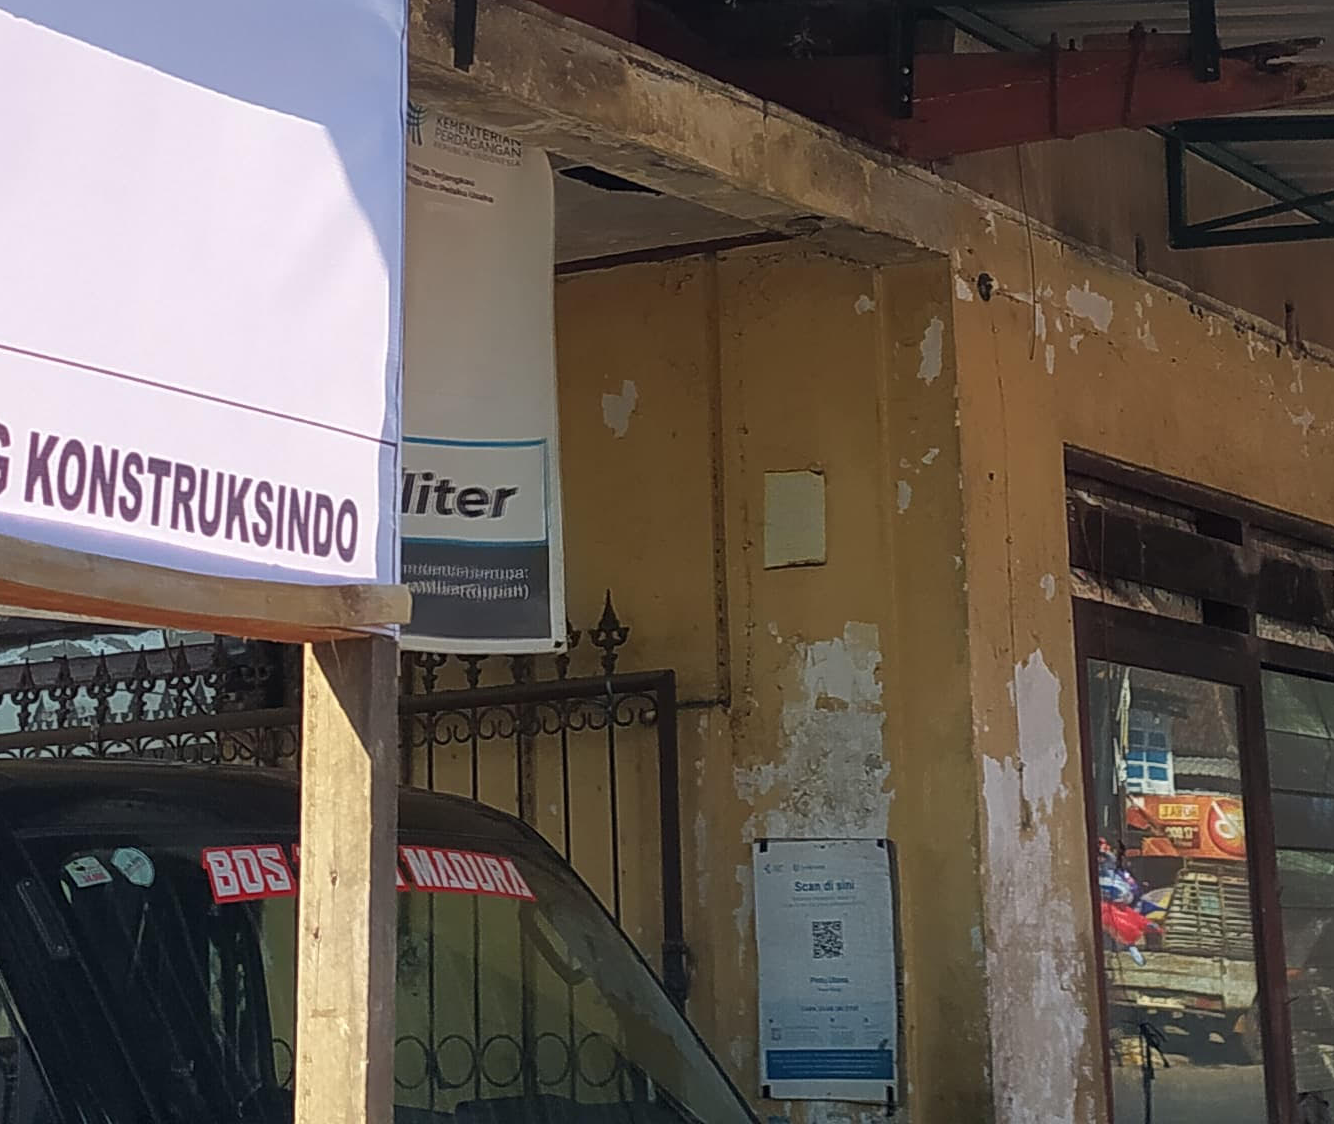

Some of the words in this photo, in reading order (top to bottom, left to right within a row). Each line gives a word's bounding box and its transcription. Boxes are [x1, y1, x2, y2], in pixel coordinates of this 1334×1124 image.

[435, 127, 522, 158] PERDAGANGAN
[436, 116, 521, 146] KEMENTERIAN
[24, 429, 359, 564] KONSTRUKSINDO
[206, 848, 292, 897] BOS
[403, 848, 534, 897] MADURA
[794, 881, 820, 892] Scan
[824, 880, 834, 891] di
